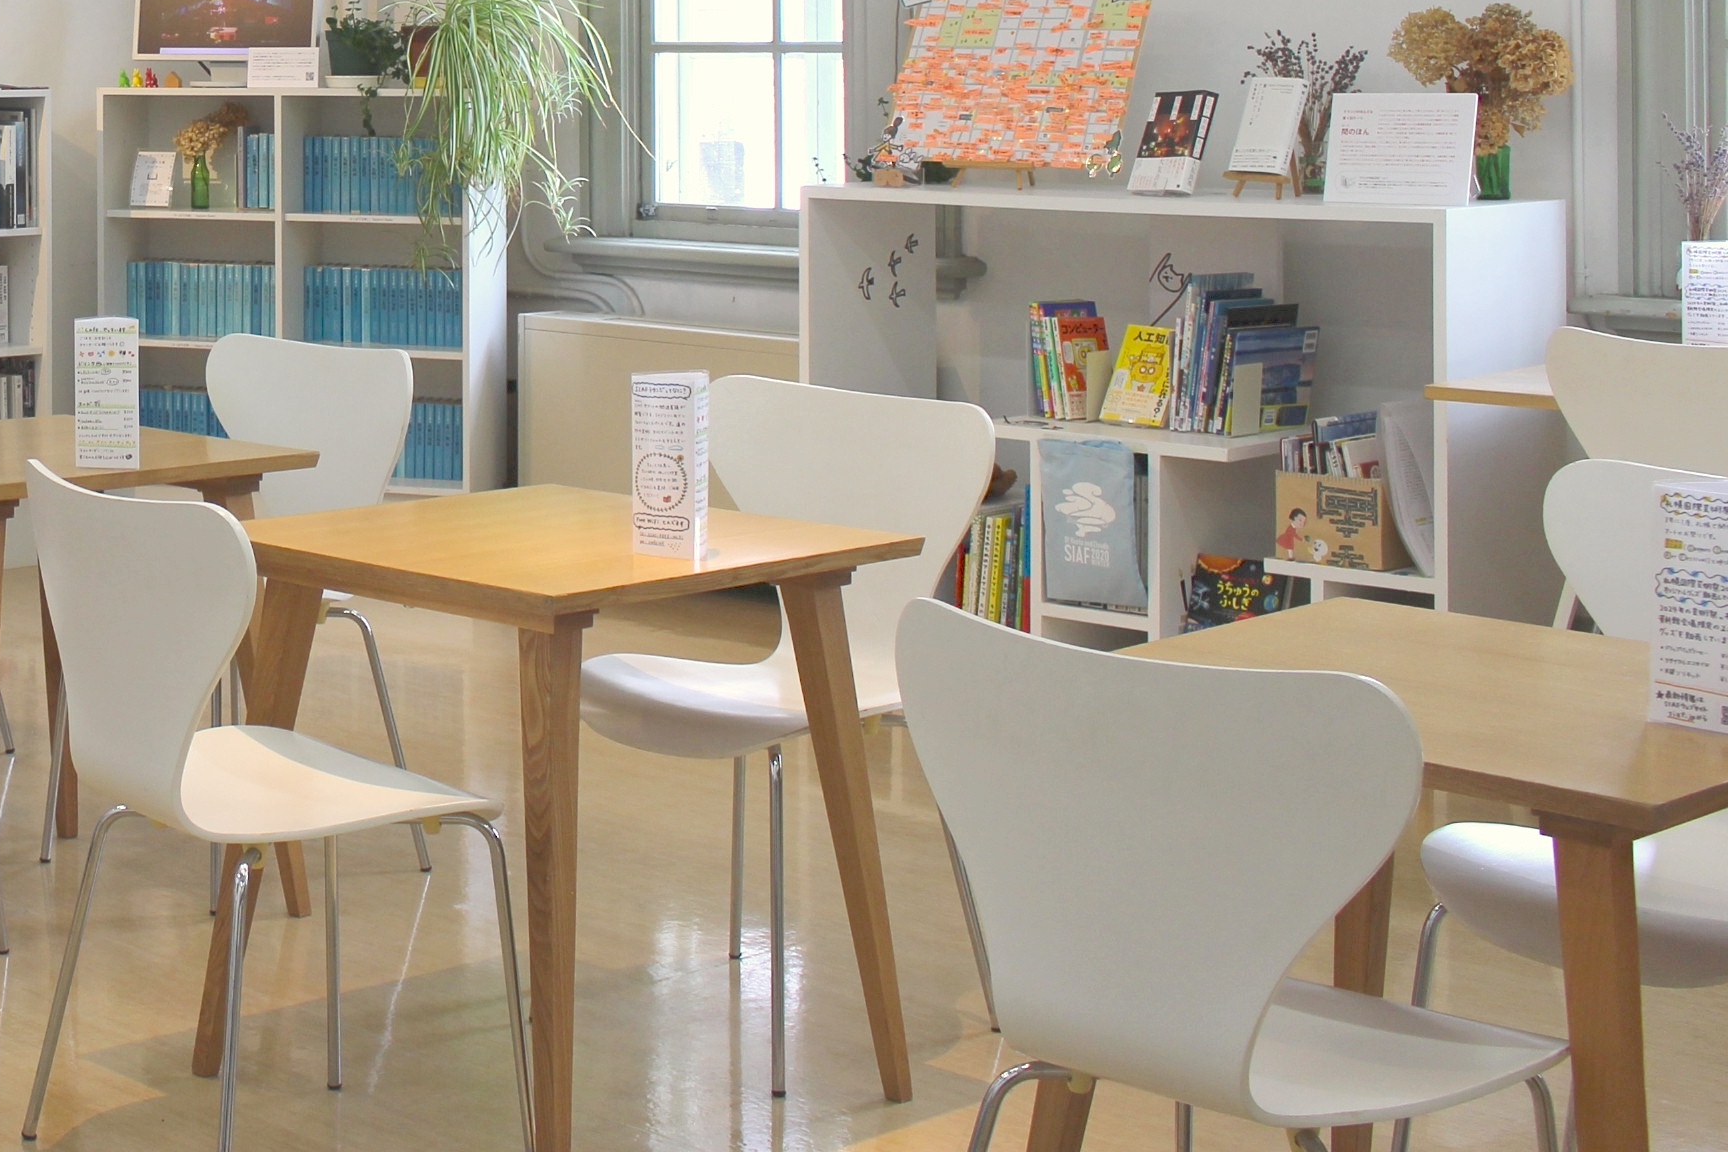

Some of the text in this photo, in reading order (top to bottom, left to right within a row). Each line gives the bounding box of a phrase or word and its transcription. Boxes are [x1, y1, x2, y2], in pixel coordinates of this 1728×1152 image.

[1133, 331, 1169, 345] 人工知
[1064, 544, 1090, 564] SIAF
[1217, 580, 1260, 597] うちゅうの
[1220, 595, 1252, 610] ふしぎ
